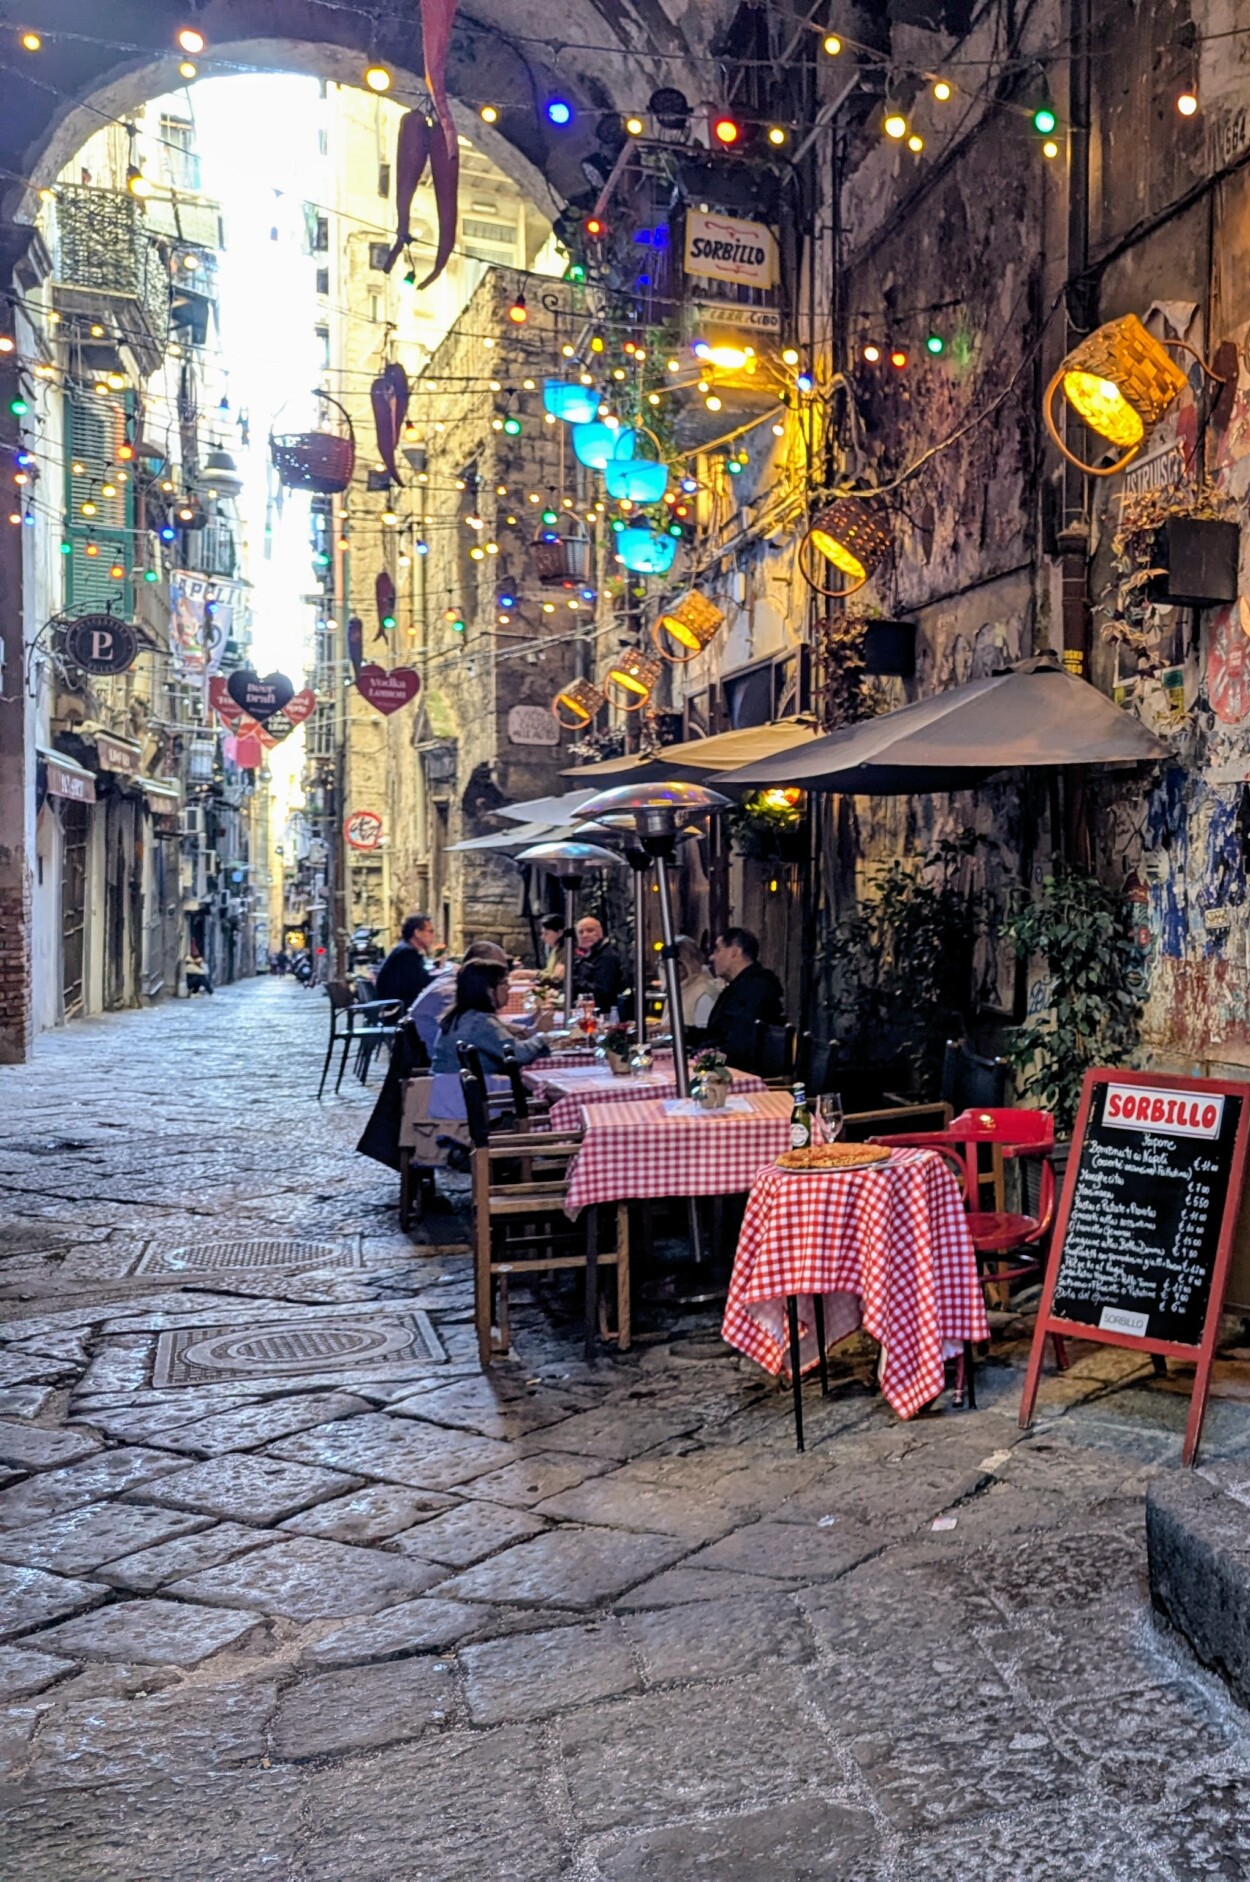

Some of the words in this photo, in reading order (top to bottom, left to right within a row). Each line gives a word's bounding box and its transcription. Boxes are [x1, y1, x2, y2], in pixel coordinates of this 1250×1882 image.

[690, 238, 765, 266] SORBILLO
[1109, 1094, 1217, 1129] SORBILLO
[1104, 1314, 1144, 1329] SORBILLO
